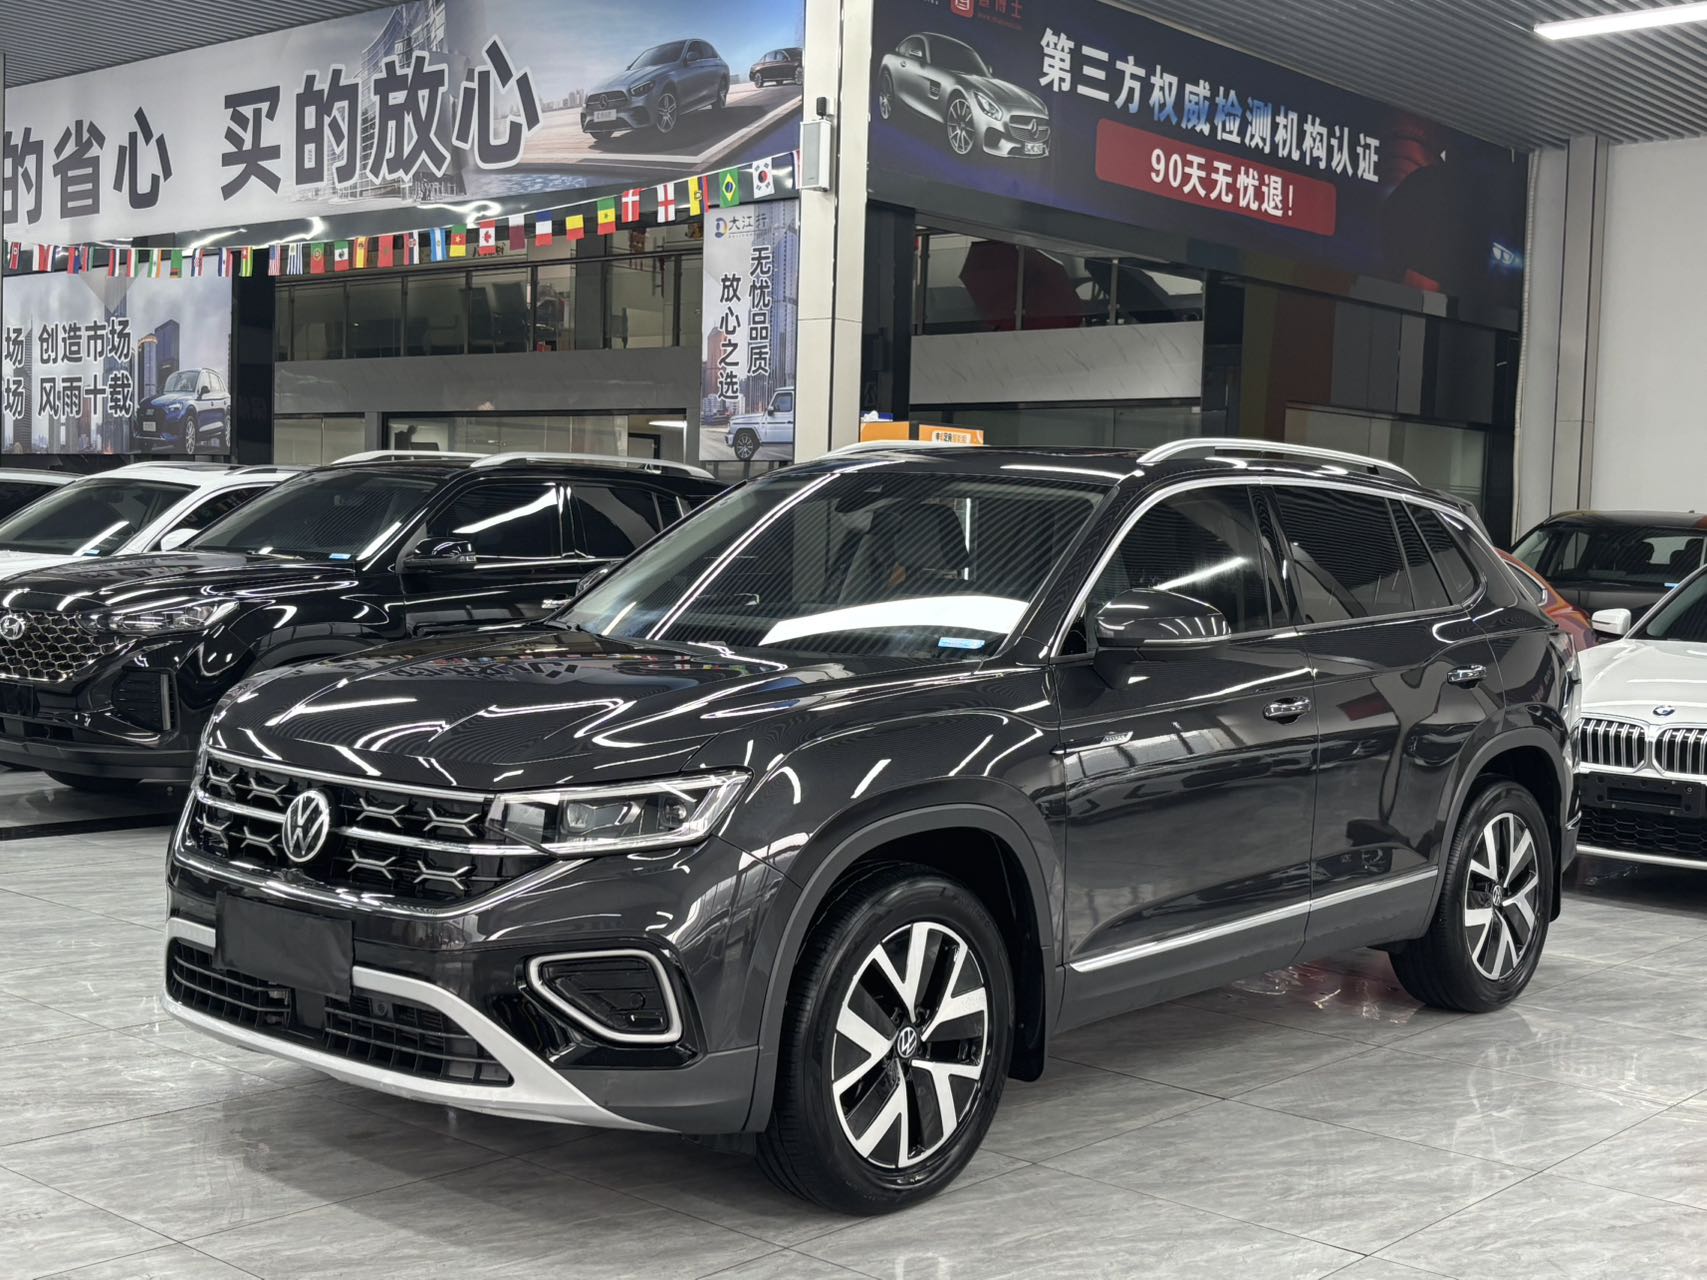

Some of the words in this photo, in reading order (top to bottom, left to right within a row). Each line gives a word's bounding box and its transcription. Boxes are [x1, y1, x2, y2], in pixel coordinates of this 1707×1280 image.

[4, 106, 172, 224] 的省心
[221, 40, 541, 200] 买的放心
[1039, 27, 1380, 183] 第三方权威检测机构认证
[729, 213, 767, 230] 大江行
[4, 327, 24, 366] 场
[38, 319, 131, 364] 创造市场
[718, 273, 742, 400] 放心之选
[750, 246, 772, 374] 无忧品质
[4, 378, 25, 418] 场
[38, 372, 133, 418] 风雨十载
